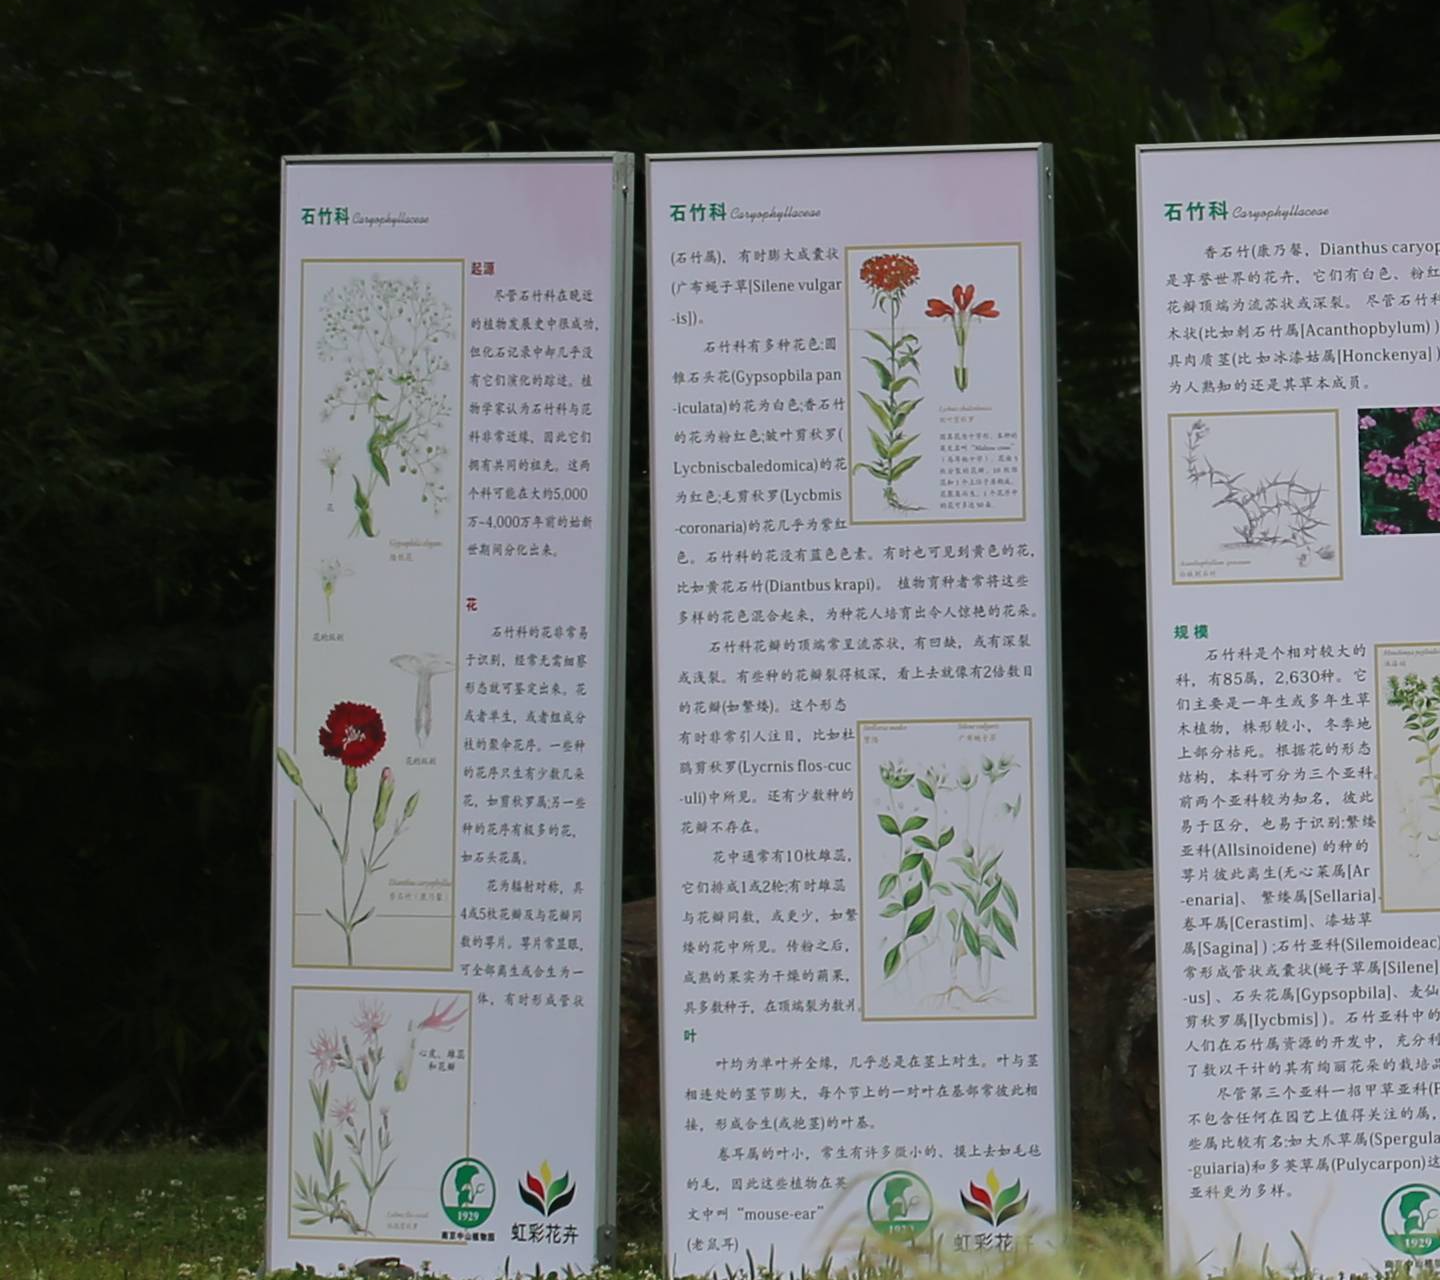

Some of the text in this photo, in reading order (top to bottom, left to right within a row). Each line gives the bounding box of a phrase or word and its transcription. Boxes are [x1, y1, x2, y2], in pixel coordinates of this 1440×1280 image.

[301, 208, 349, 225] 石竹科
[670, 202, 726, 222] 石竹科
[1164, 201, 1228, 221] 石竹科
[471, 262, 494, 275] 起源
[466, 598, 477, 611] 花
[492, 625, 587, 639] 石竹科的花非常易
[681, 820, 758, 834] 花瓣不存在。
[1323, 839, 1368, 853] 的种的
[684, 1029, 696, 1042] 叶
[458, 1210, 479, 1221] 1929
[511, 1223, 579, 1244] 虹彩花卉
[1405, 1236, 1432, 1248] 1929
